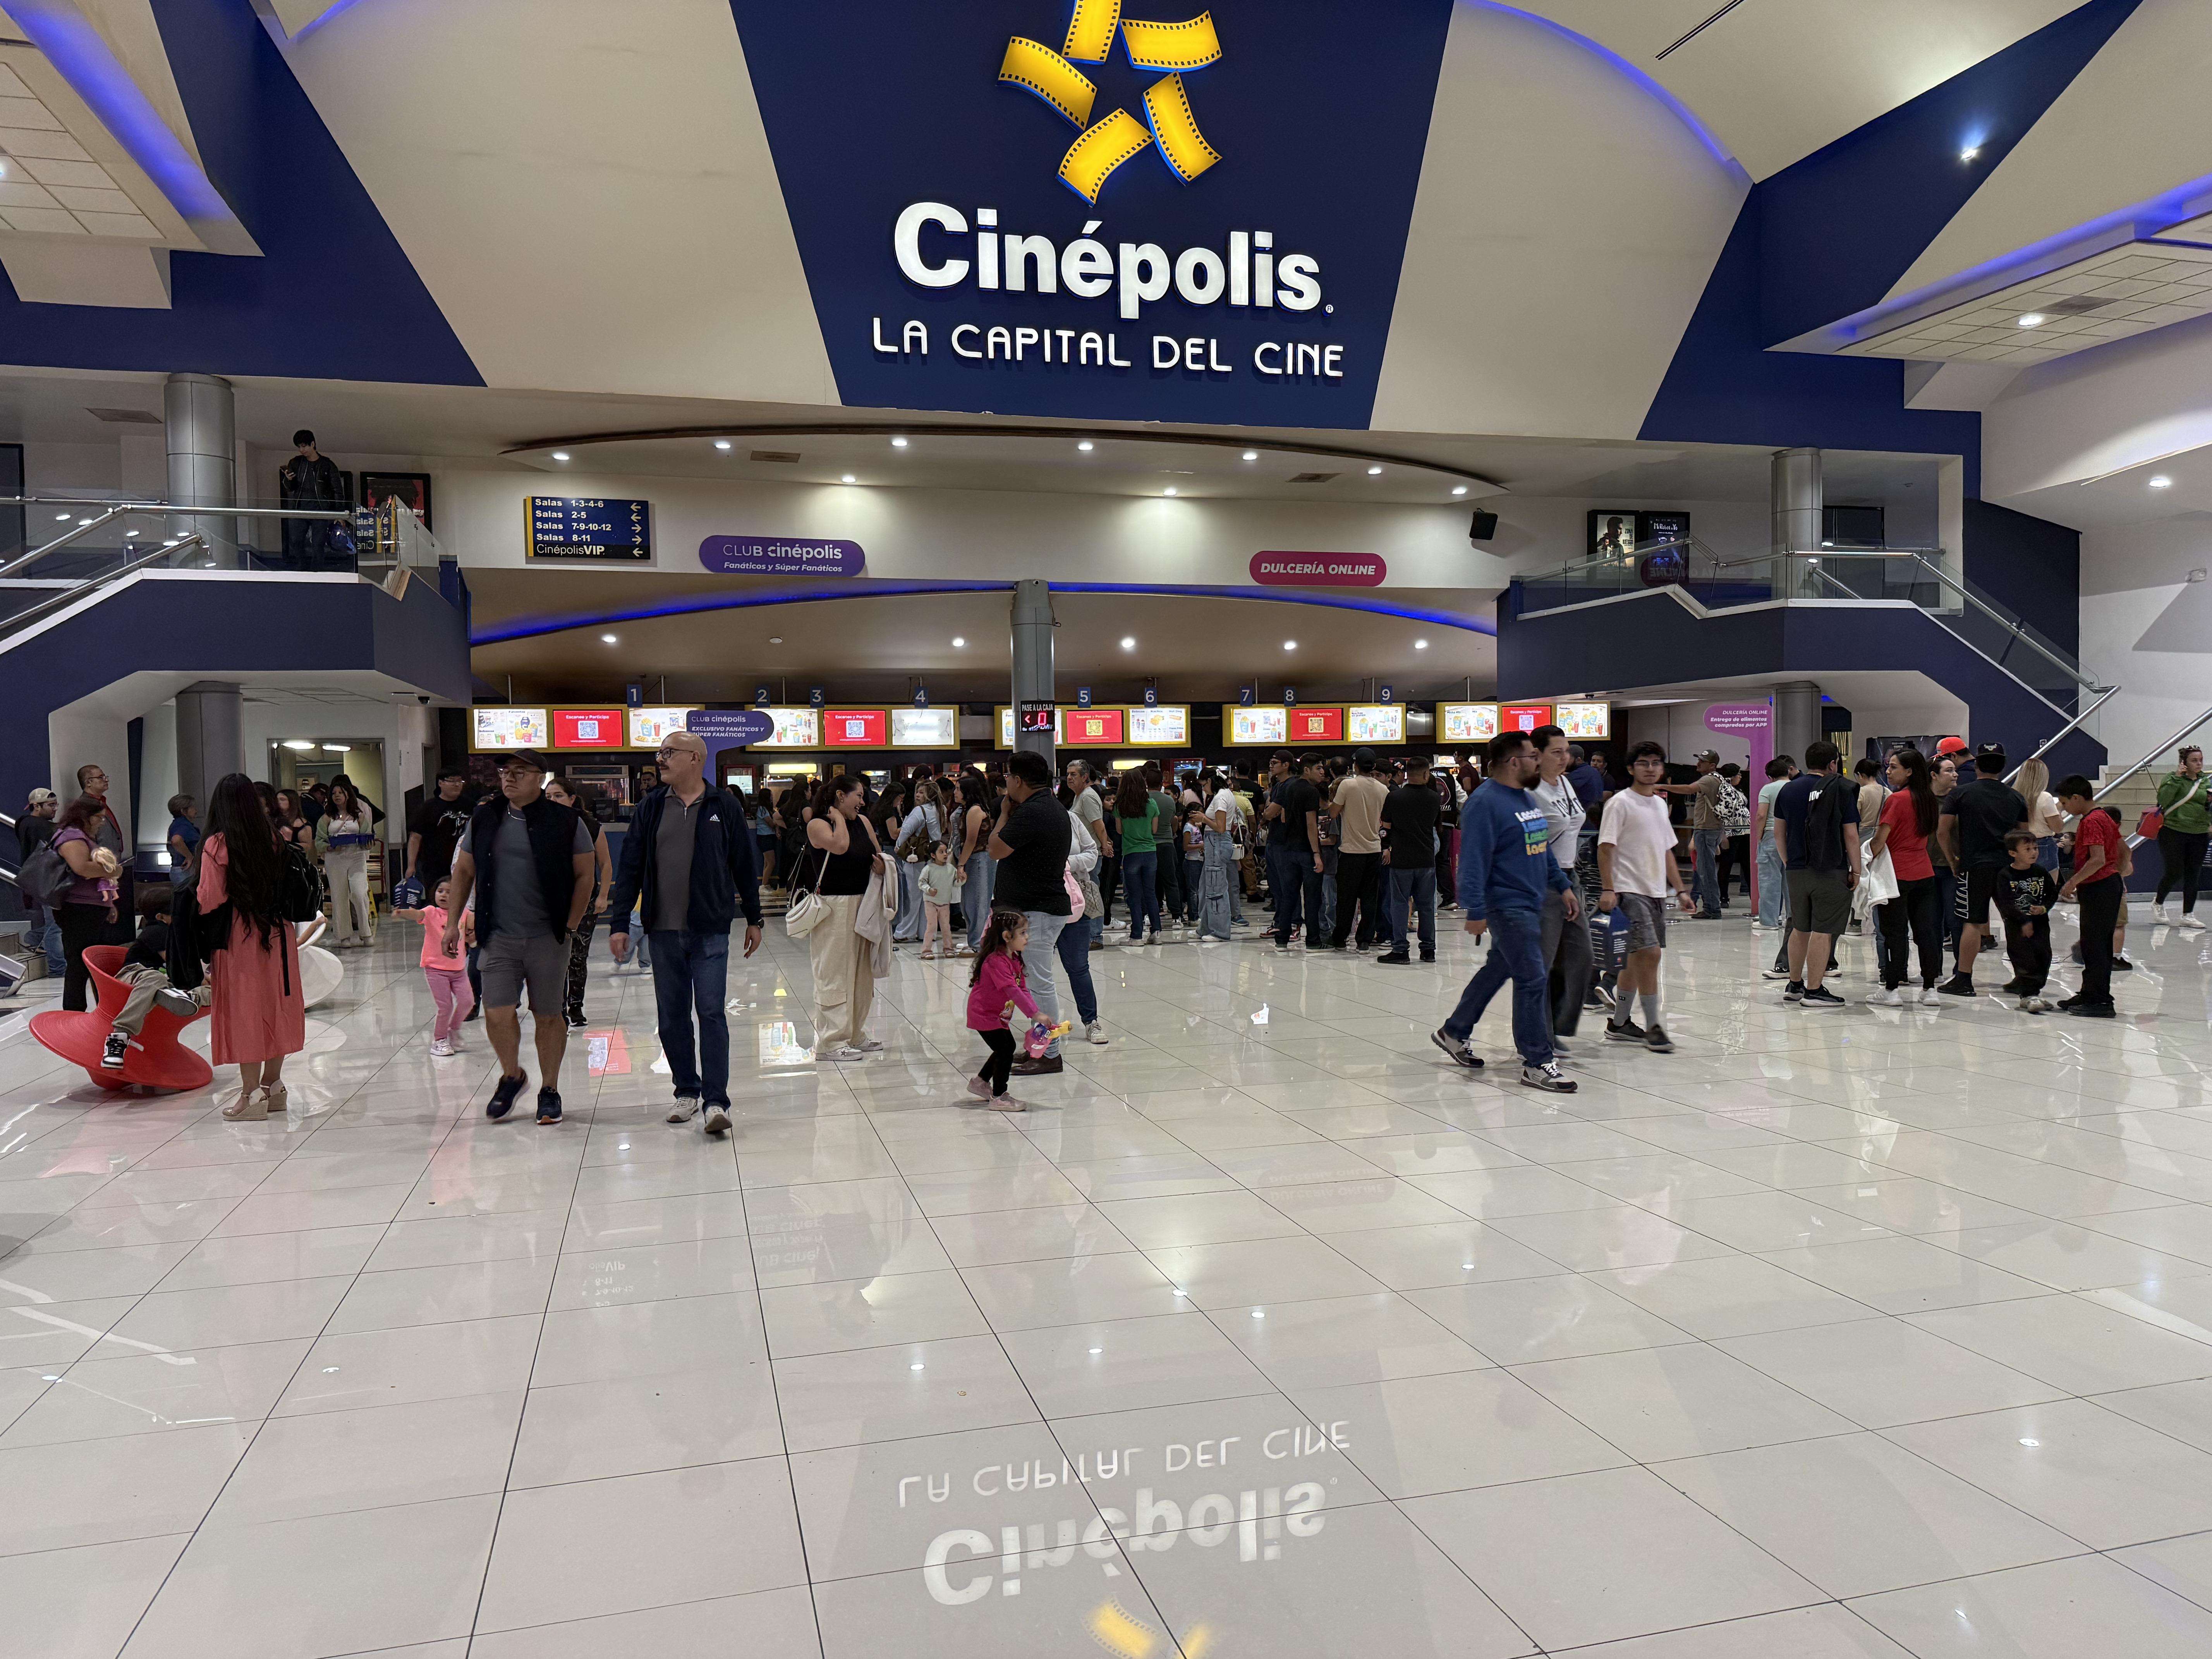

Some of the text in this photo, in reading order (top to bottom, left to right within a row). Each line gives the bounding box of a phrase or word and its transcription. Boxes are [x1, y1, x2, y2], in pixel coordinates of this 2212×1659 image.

[894, 201, 1322, 320] Cinépolis
[874, 318, 1343, 377] LA CAPITAL DEL CINE
[572, 523, 611, 531] 7-9-10-12
[723, 543, 842, 561] CLUB cinépolis
[724, 562, 766, 570] Fanáticos
[1261, 562, 1376, 575] DULCERÍA ONLINE
[630, 689, 637, 702] 1
[757, 689, 767, 702] 2
[812, 690, 821, 702] 3
[915, 690, 926, 702] 4
[1080, 690, 1088, 702] 5
[1146, 690, 1154, 702] 6
[1242, 690, 1250, 701] 7
[1285, 690, 1294, 701] 8
[1382, 689, 1390, 701] 9
